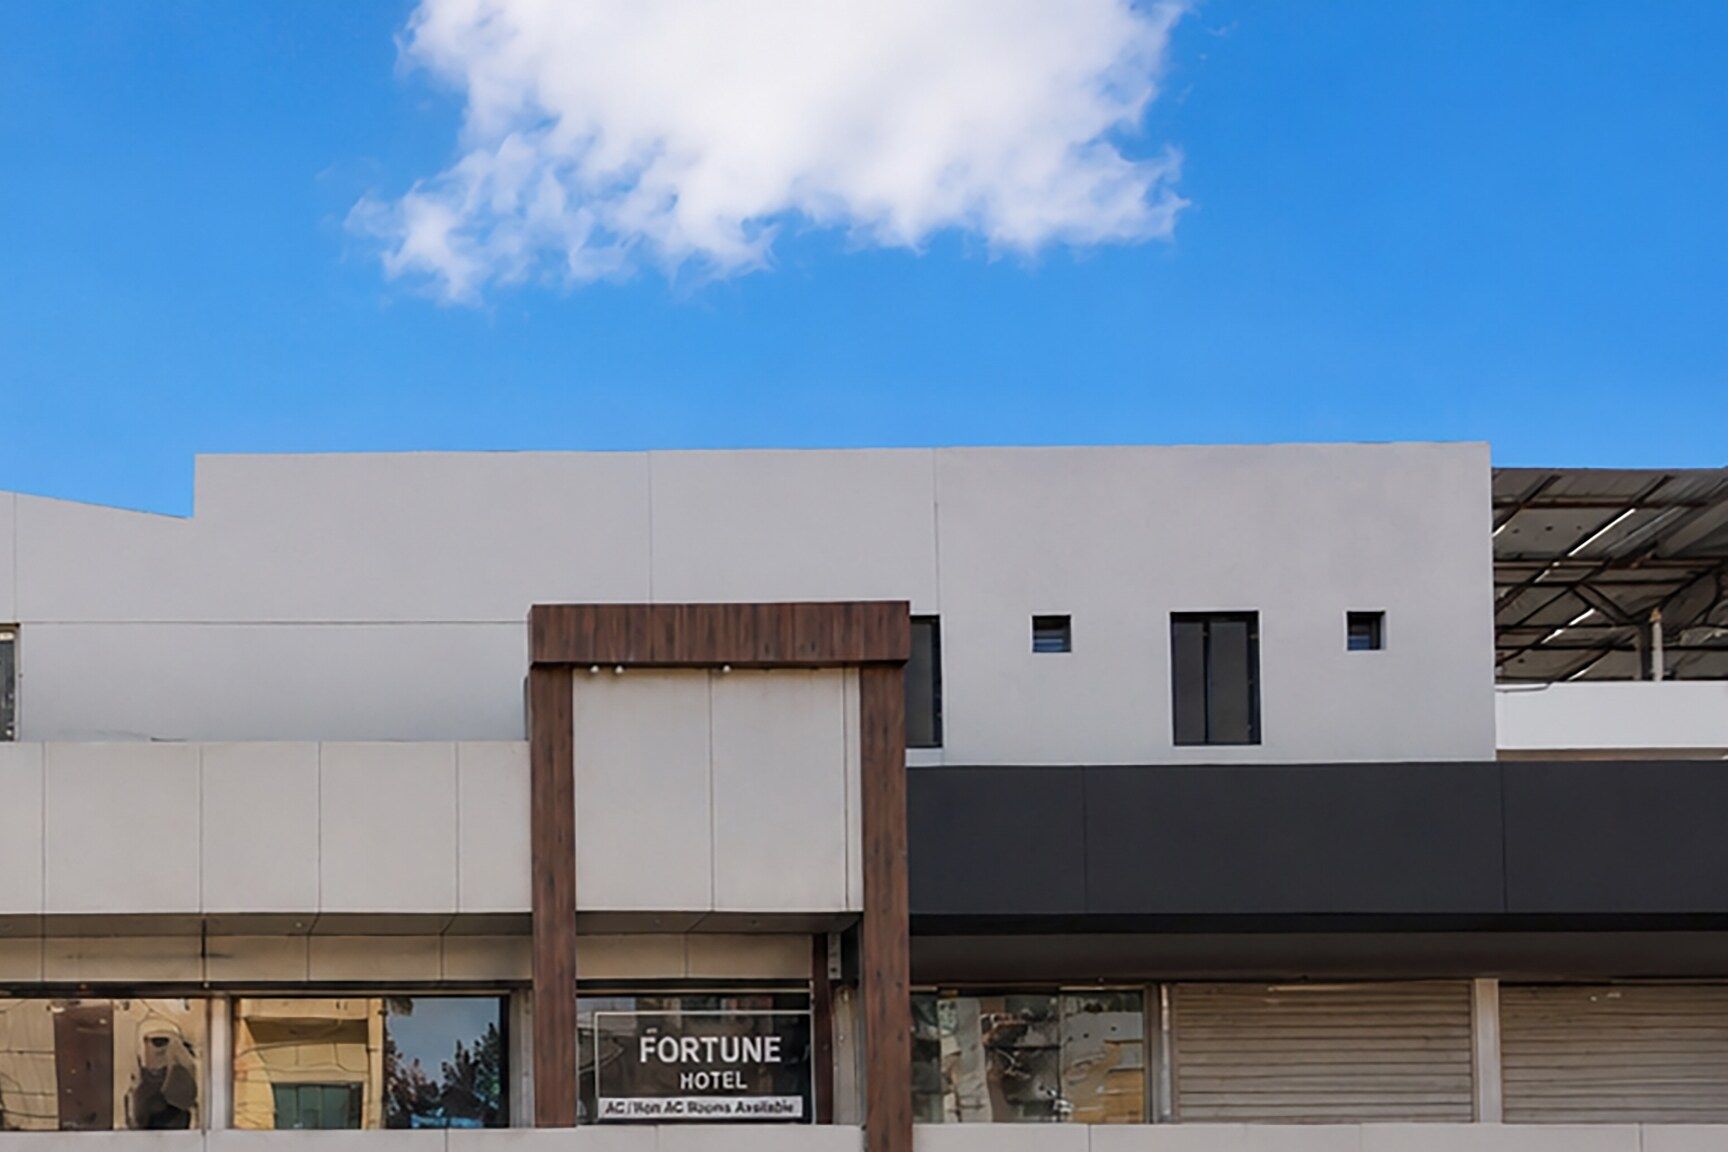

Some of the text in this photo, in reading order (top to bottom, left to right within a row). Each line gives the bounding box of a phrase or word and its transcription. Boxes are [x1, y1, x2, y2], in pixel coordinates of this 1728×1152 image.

[640, 1036, 781, 1063] FORTUNE
[680, 1071, 748, 1089] HOTEL
[664, 1101, 683, 1114] AC
